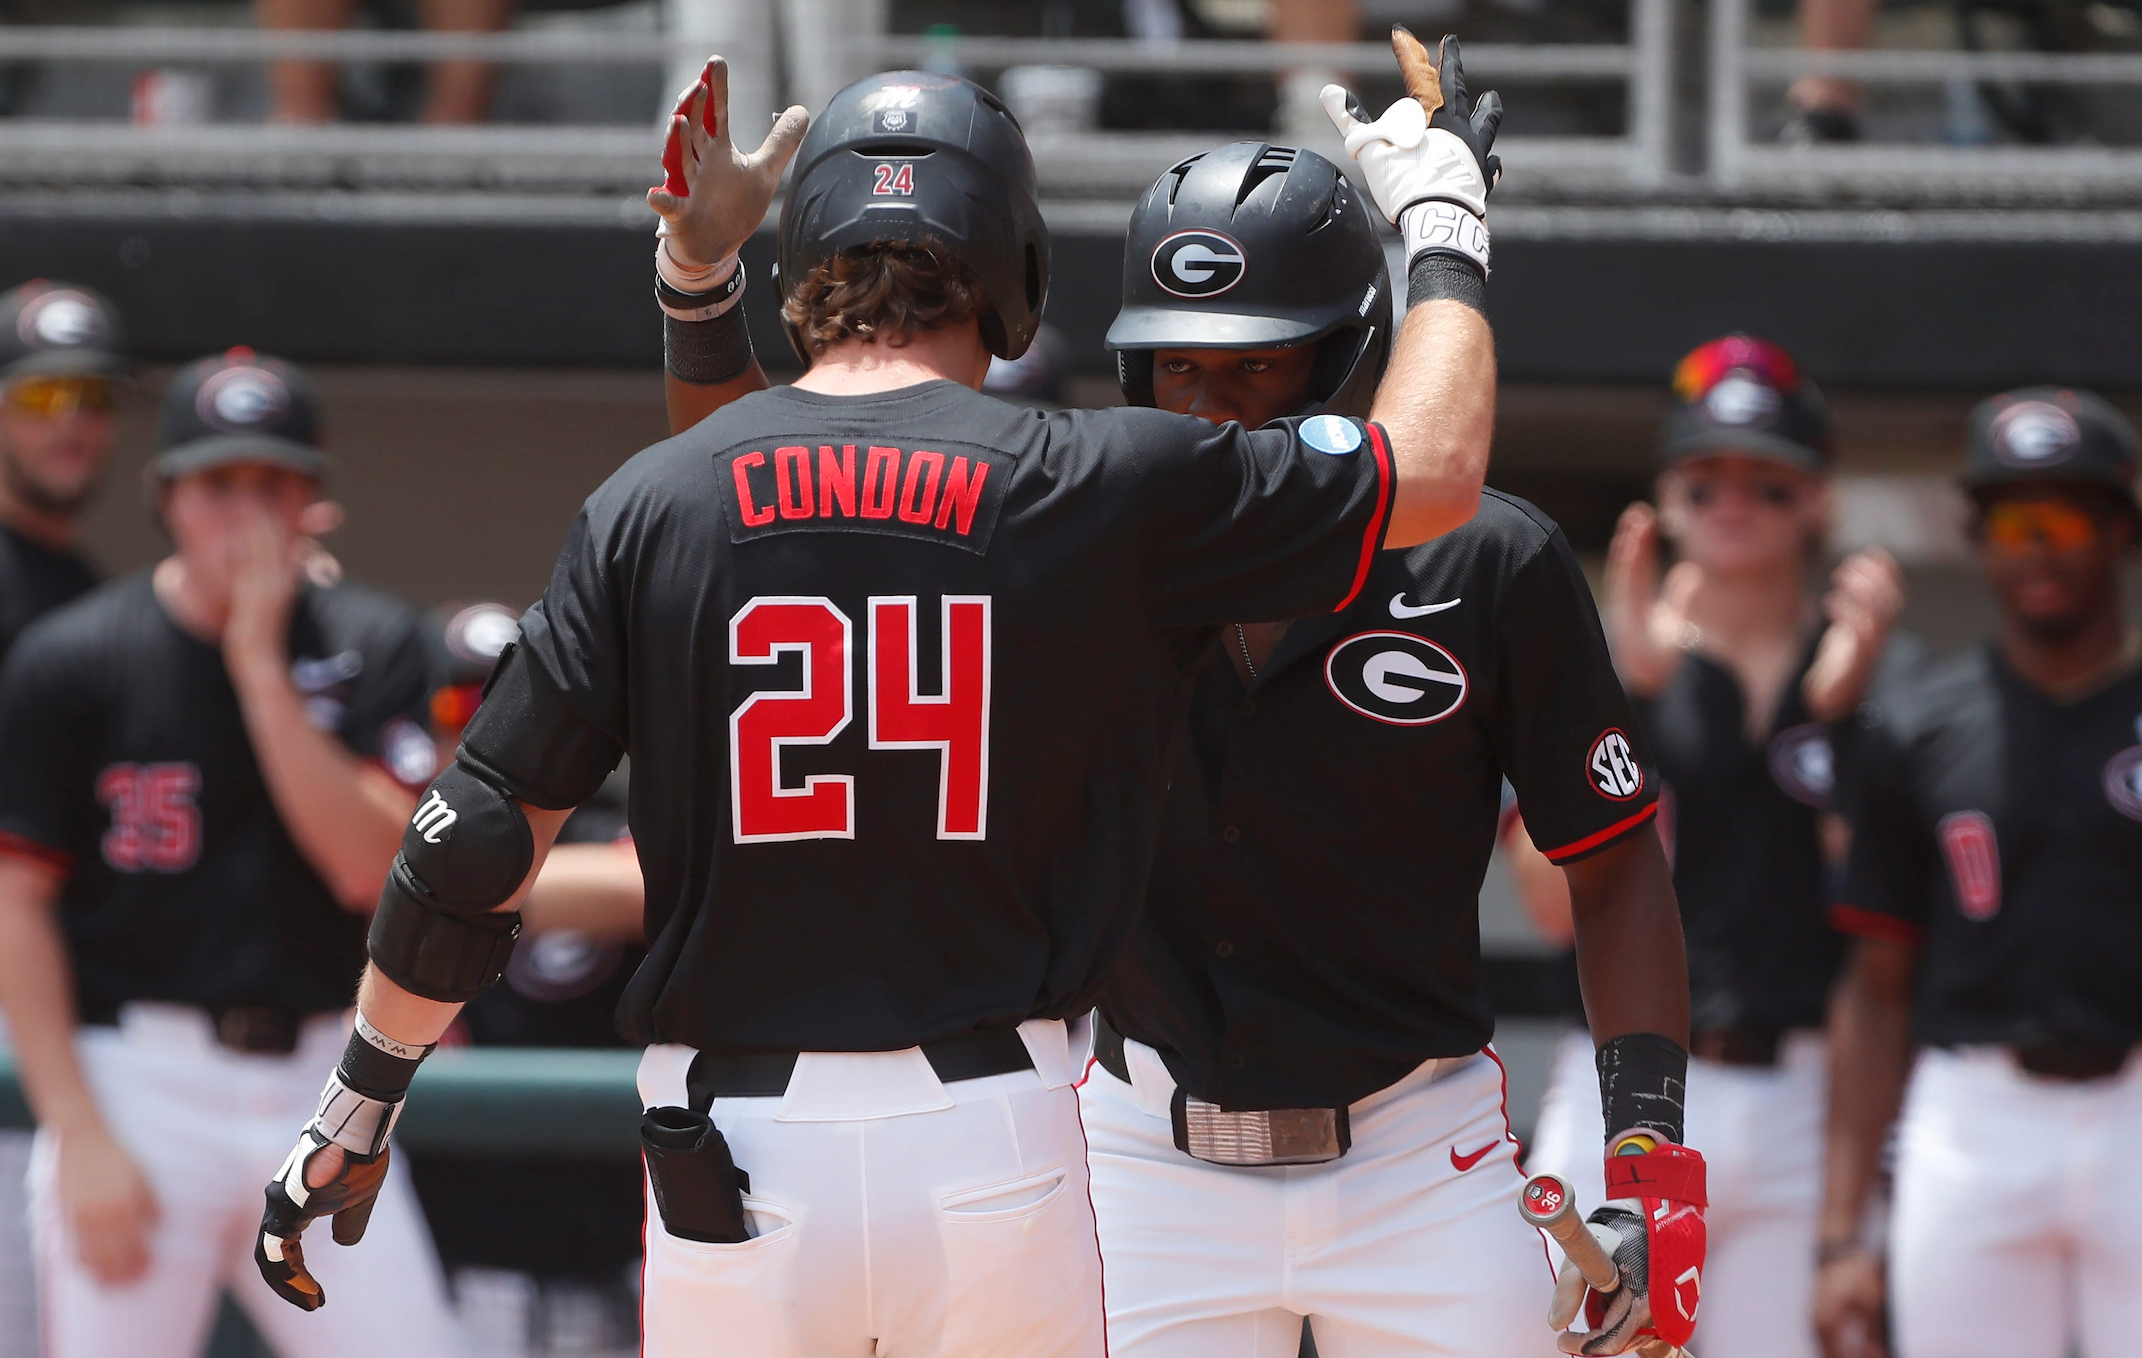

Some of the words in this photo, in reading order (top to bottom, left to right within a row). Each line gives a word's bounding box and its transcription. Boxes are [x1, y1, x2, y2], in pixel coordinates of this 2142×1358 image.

[872, 163, 915, 196] 24
[731, 444, 991, 536] CONDON
[729, 594, 992, 844] 24
[1592, 732, 1640, 797] SEC
[97, 764, 202, 873] 35
[1540, 1190, 1561, 1211] 36
